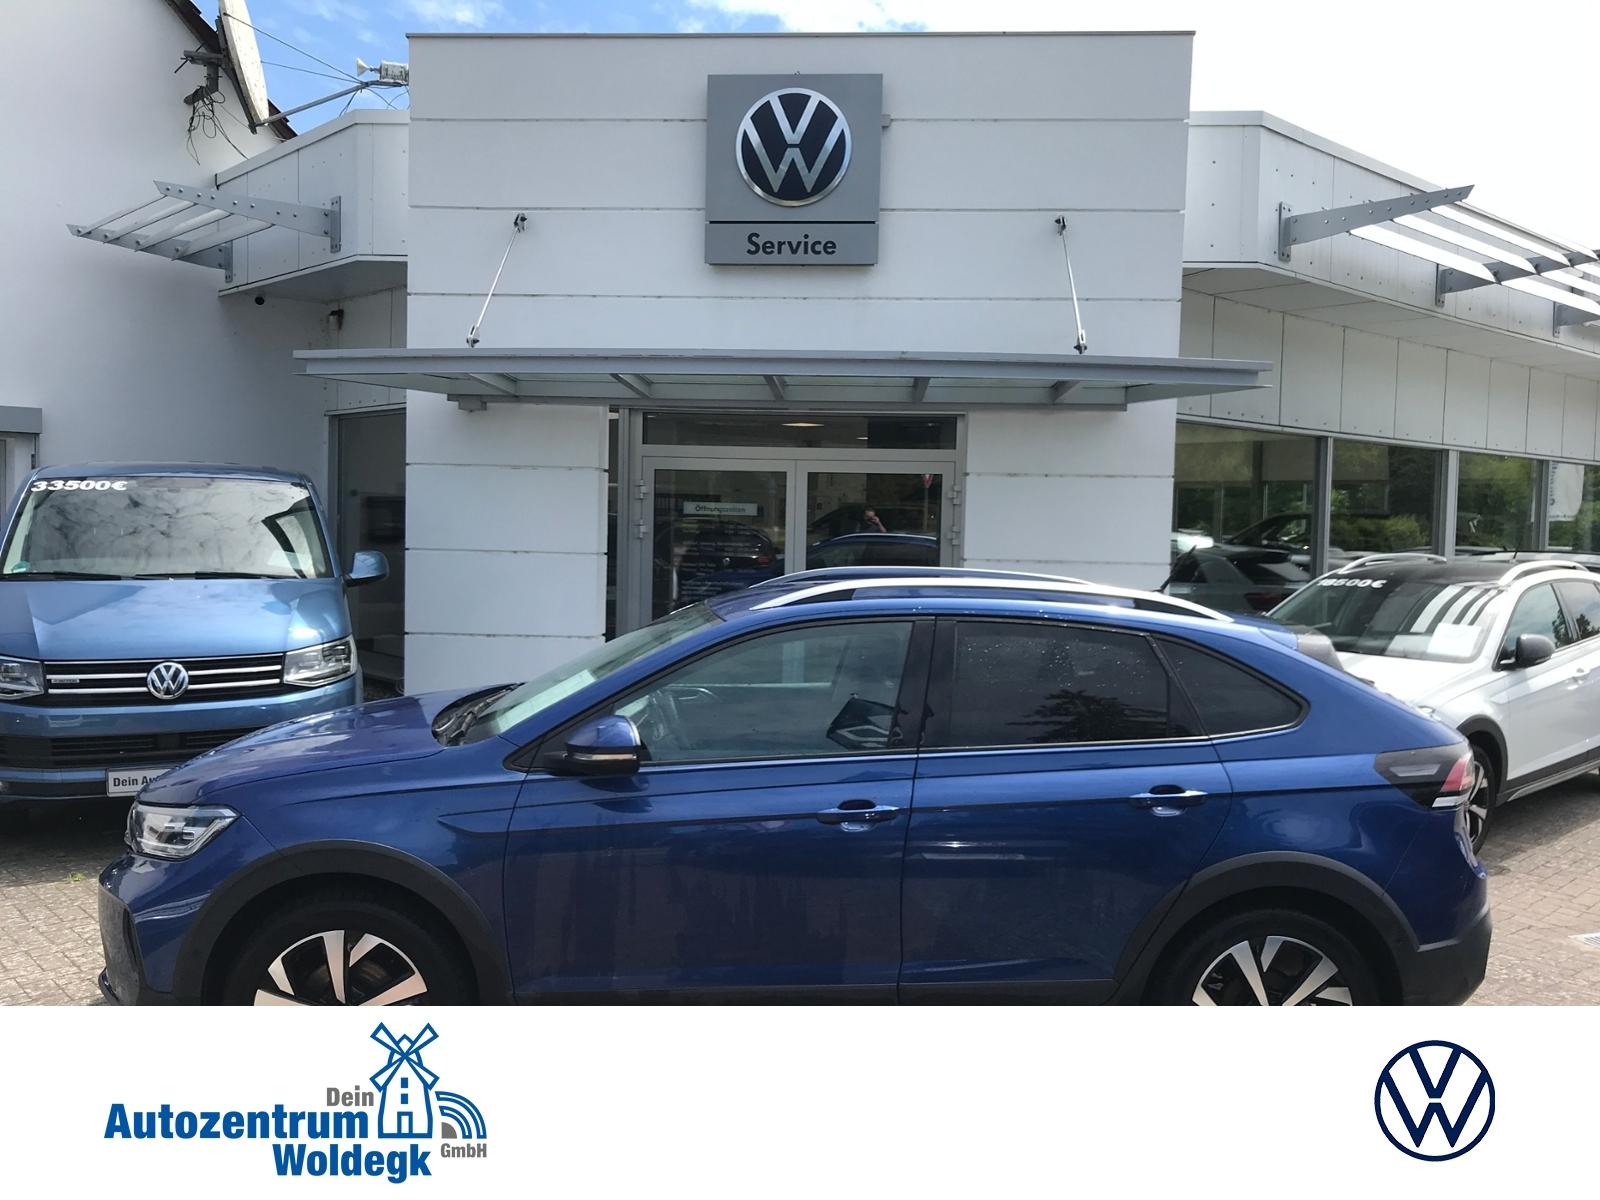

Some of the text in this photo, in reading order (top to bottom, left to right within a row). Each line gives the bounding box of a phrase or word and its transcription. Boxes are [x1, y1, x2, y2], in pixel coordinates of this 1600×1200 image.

[736, 87, 852, 207] VW
[746, 232, 837, 256] Service
[31, 480, 128, 492] 33500€
[113, 777, 138, 787] Dein
